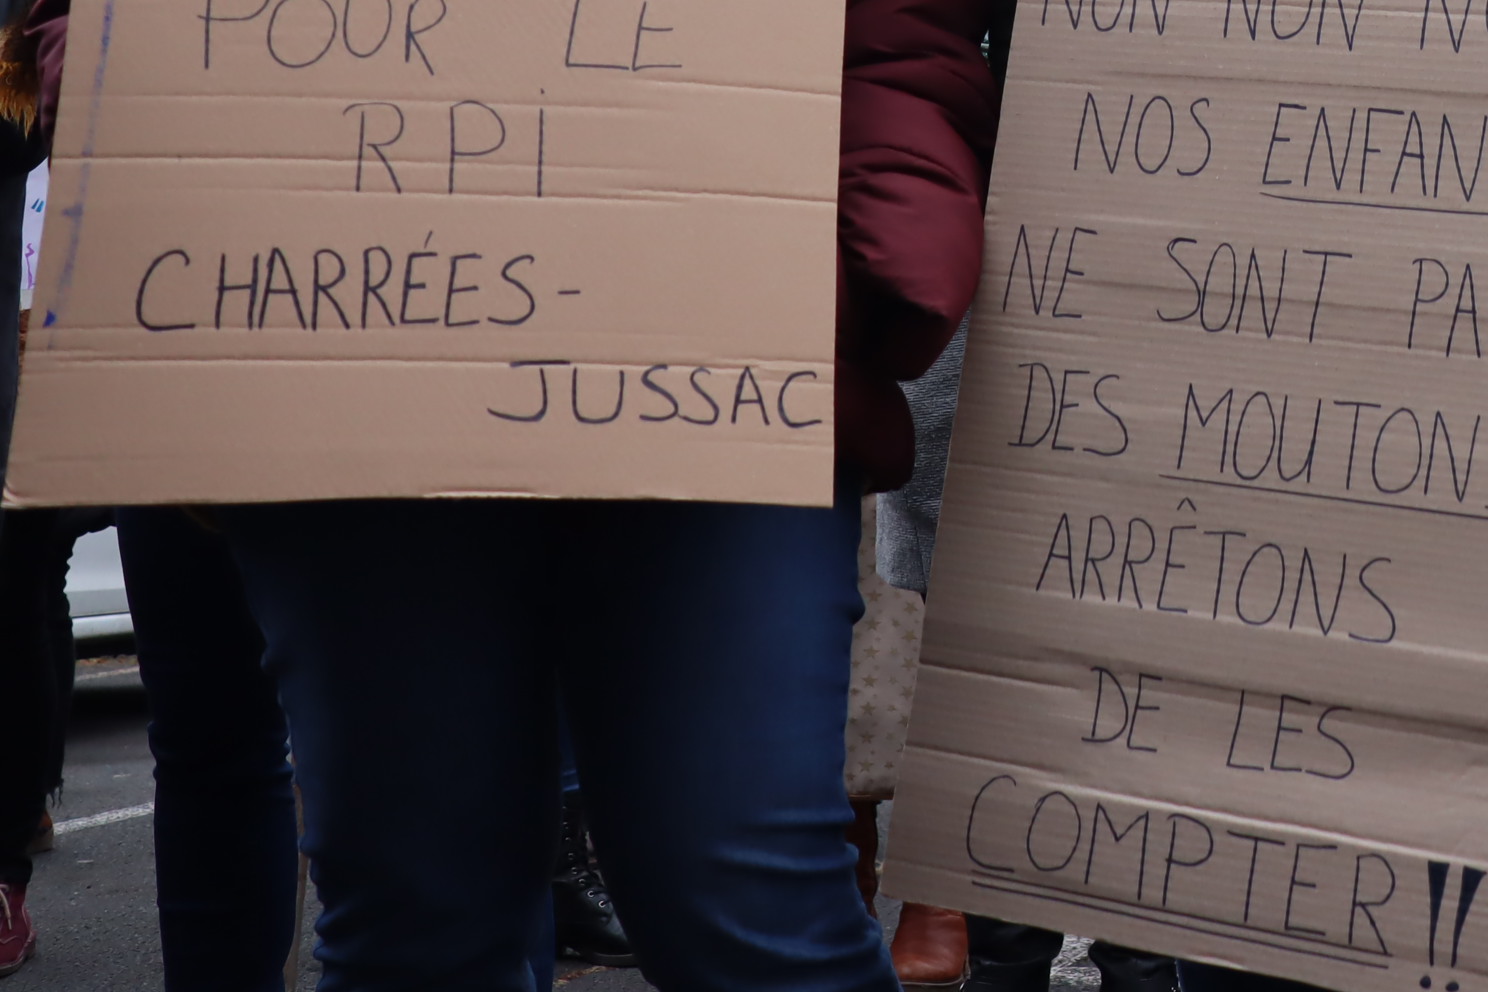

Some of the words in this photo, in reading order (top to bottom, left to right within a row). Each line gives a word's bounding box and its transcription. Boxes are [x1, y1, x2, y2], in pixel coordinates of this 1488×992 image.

[1074, 92, 1212, 176] NOS
[1003, 224, 1097, 319] NE
[1156, 237, 1352, 343] SONT
[486, 360, 824, 429] JUSSAC
[1008, 363, 1129, 456] DES
[1036, 497, 1397, 643] ARRÊTONS
[1081, 666, 1162, 752] DE
[1226, 689, 1355, 780] LES
